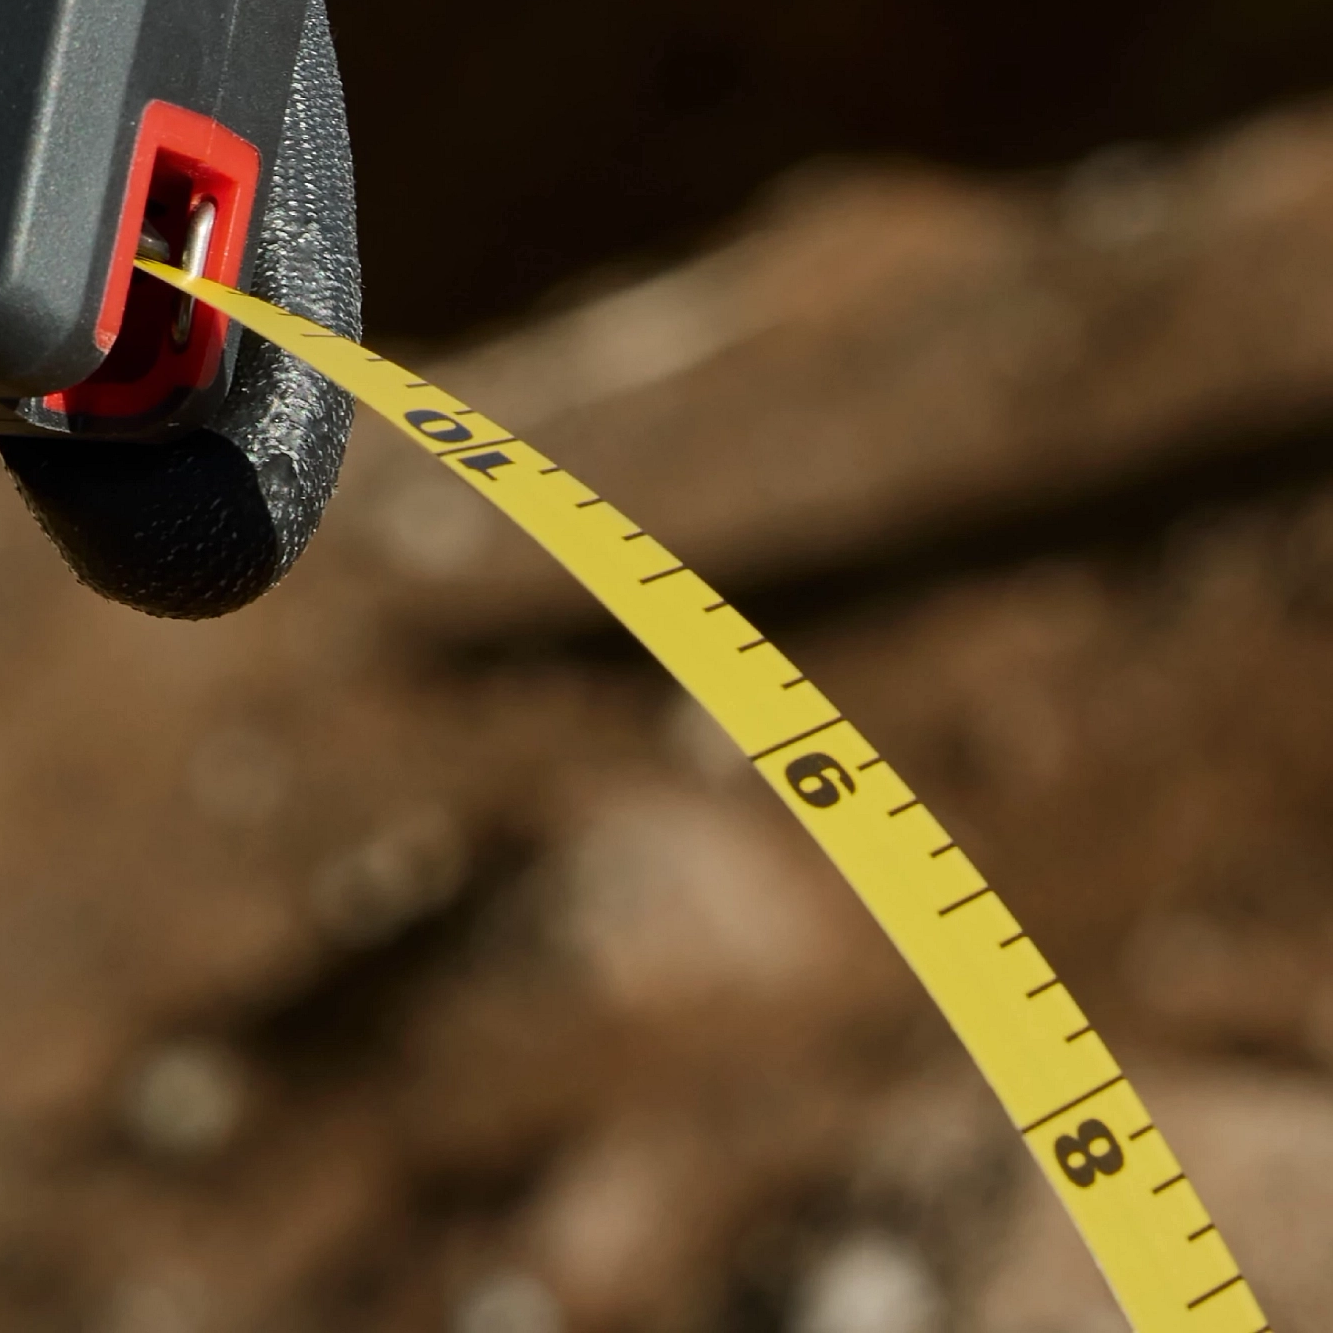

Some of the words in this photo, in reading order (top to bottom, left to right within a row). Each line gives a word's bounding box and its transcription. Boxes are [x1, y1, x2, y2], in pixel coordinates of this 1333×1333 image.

[403, 409, 514, 481] 10
[783, 751, 856, 809] 9
[1054, 1118, 1124, 1189] 8
